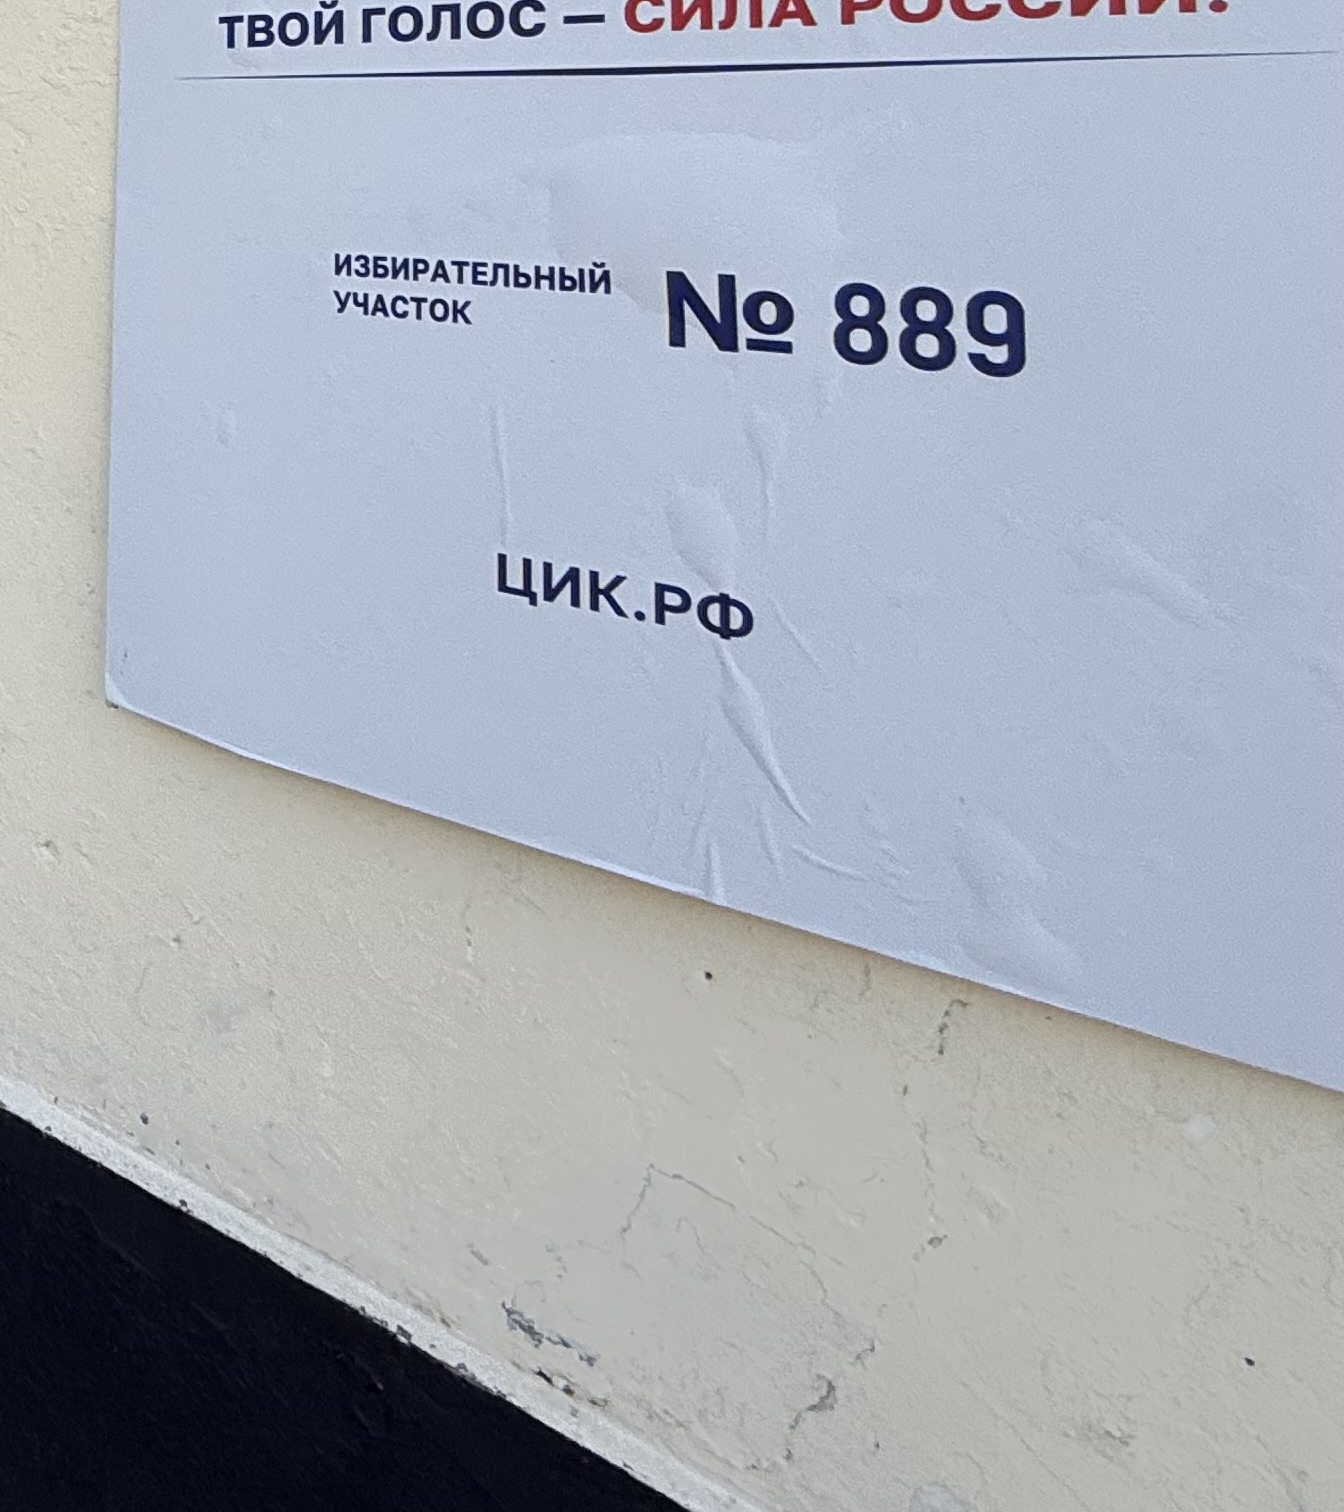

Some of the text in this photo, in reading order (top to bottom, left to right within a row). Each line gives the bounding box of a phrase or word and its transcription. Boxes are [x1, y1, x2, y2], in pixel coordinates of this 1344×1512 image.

[333, 251, 613, 296] ИЗБИРАТЕЛЬНЫЙ
[333, 289, 474, 326] УЧАСТОК
[664, 269, 1028, 379] № 889
[496, 551, 755, 642] ЦИК.РФ
